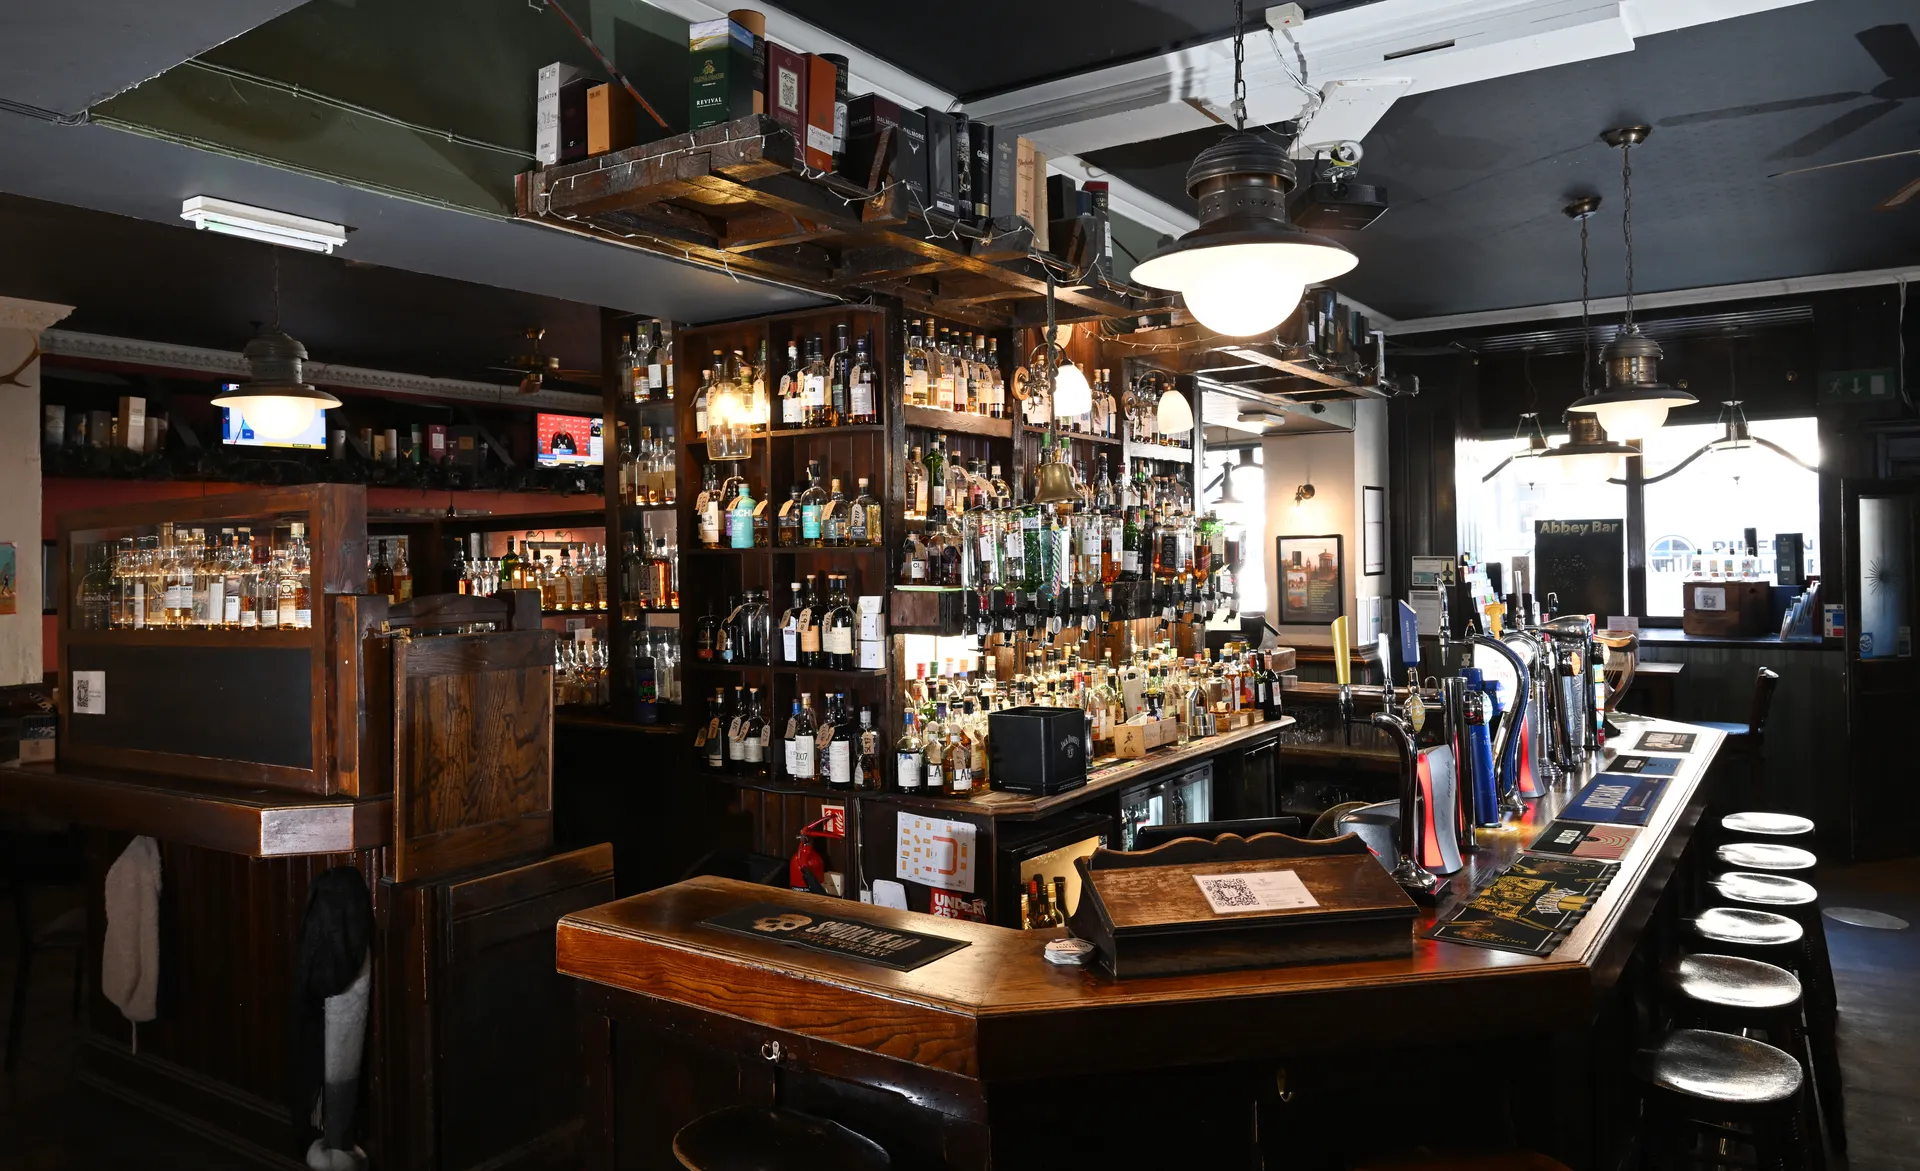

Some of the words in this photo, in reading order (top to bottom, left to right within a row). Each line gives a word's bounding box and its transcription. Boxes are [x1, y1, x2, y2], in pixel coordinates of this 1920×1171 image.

[696, 96, 722, 106] REVIVAL
[1540, 521, 1589, 536] Abbey
[1592, 521, 1618, 532] Bar
[806, 920, 922, 951] SMOKEHEAD
